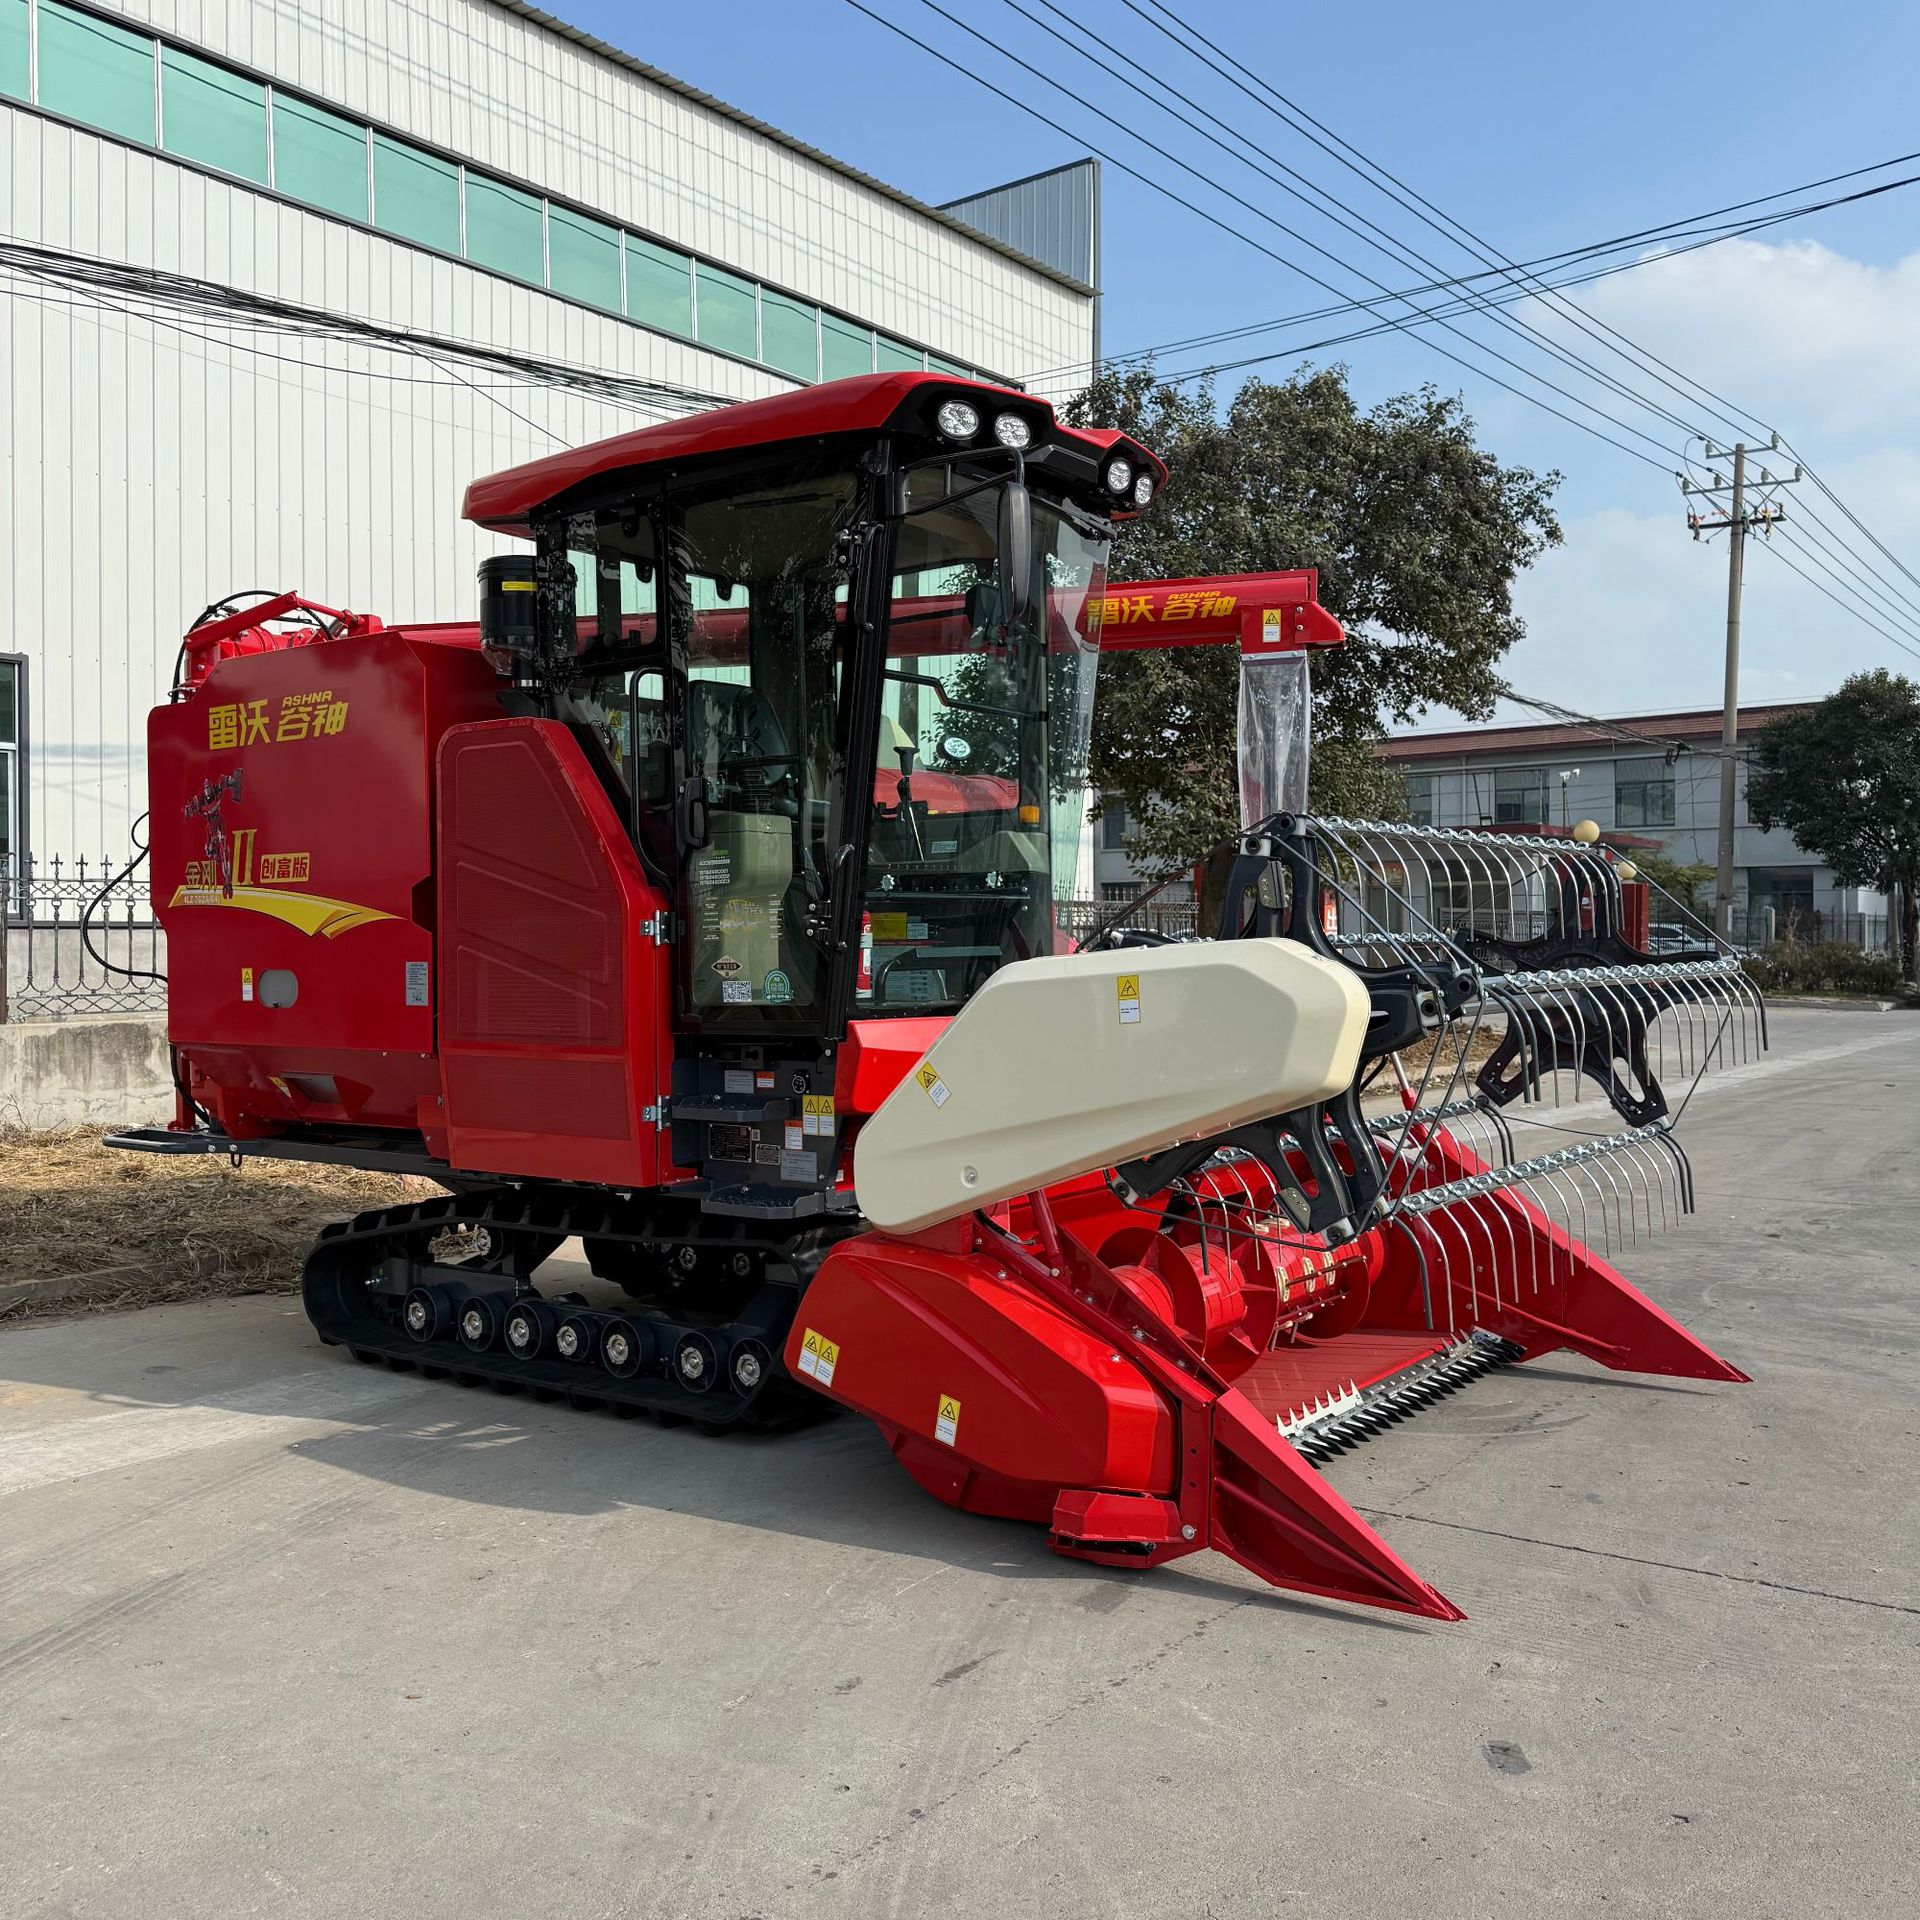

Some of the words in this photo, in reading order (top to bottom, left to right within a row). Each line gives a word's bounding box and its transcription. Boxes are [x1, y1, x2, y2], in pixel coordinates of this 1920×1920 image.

[282, 690, 333, 708] ASHNA
[208, 699, 271, 750] 雷沃
[276, 701, 349, 742] 谷神
[261, 857, 309, 880] 创富版
